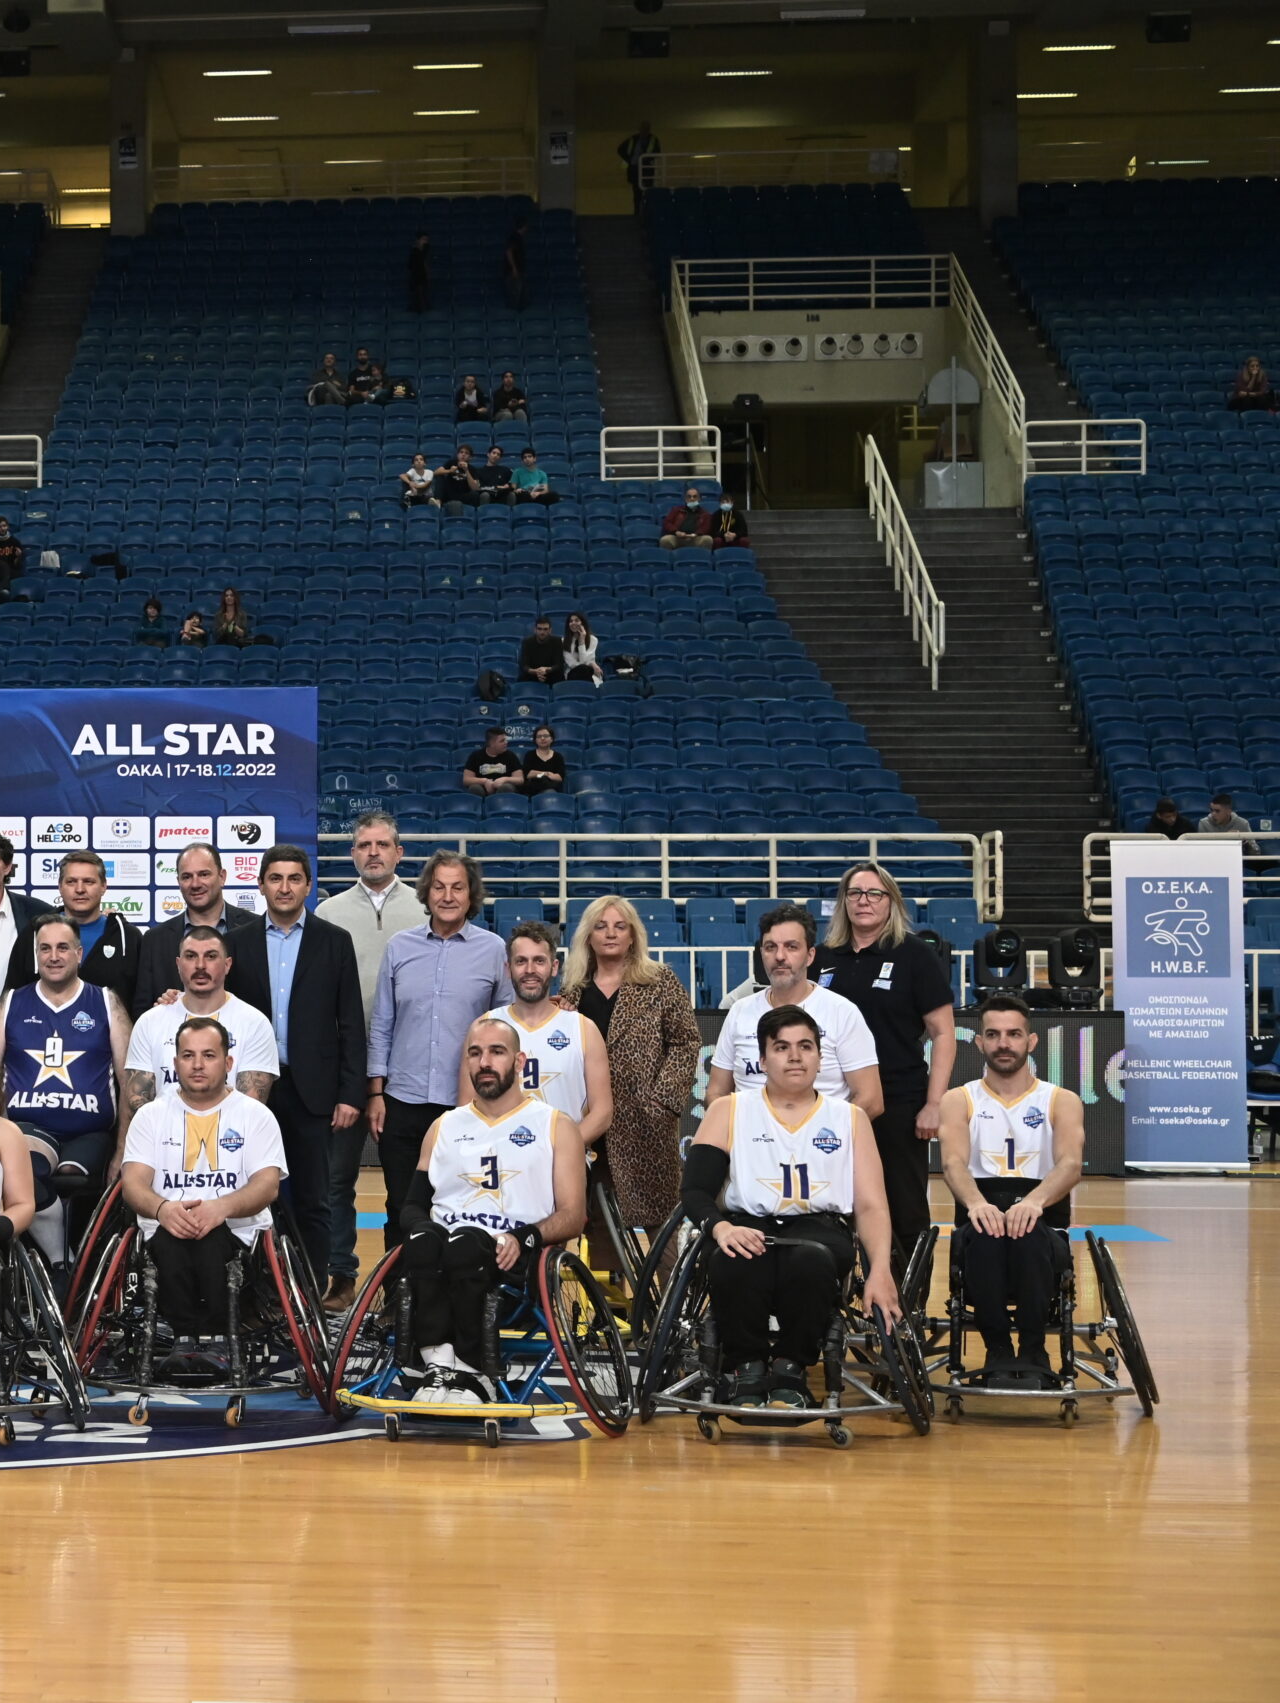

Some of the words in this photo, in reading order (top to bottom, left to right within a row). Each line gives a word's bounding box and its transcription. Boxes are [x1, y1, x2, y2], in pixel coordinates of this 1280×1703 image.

[71, 723, 156, 755] ALL
[163, 722, 276, 756] STAR
[116, 763, 163, 777] OAKA
[174, 763, 276, 777] 17-18.12.2022
[158, 826, 210, 838] mateco
[37, 834, 82, 843] HELEXPO
[234, 856, 258, 866] BIO
[1150, 961, 1209, 974] H.W.B.F.
[1148, 995, 1208, 1005] ΟΜΟΣΠΟΝΔΙΑ
[1128, 1007, 1182, 1016] ΣΩΜΑΤΕΙΩΝ
[1183, 1007, 1228, 1016] ΕΛΛΗΝΩΝ
[1148, 1030, 1163, 1039] ΜΕ
[1165, 1030, 1210, 1039] ΑΜΑΞΙΔΙΟ
[44, 1036, 64, 1068] 9
[1127, 1059, 1171, 1069] HELLENIC
[1173, 1059, 1232, 1069] WHEELCHAIR
[522, 1057, 540, 1090] 9
[1181, 1071, 1239, 1080] FEDERATION
[7, 1091, 42, 1109] ALL
[45, 1092, 100, 1114] STAR
[1148, 1105, 1213, 1115] www.oseka.gr
[1131, 1116, 1158, 1126] Email:
[1159, 1116, 1230, 1127] oseka@oseka.gr
[1004, 1137, 1016, 1170] 1
[480, 1155, 500, 1190] 3
[162, 1172, 190, 1190] ALL
[195, 1172, 238, 1190] STAR
[779, 1162, 811, 1200] 11
